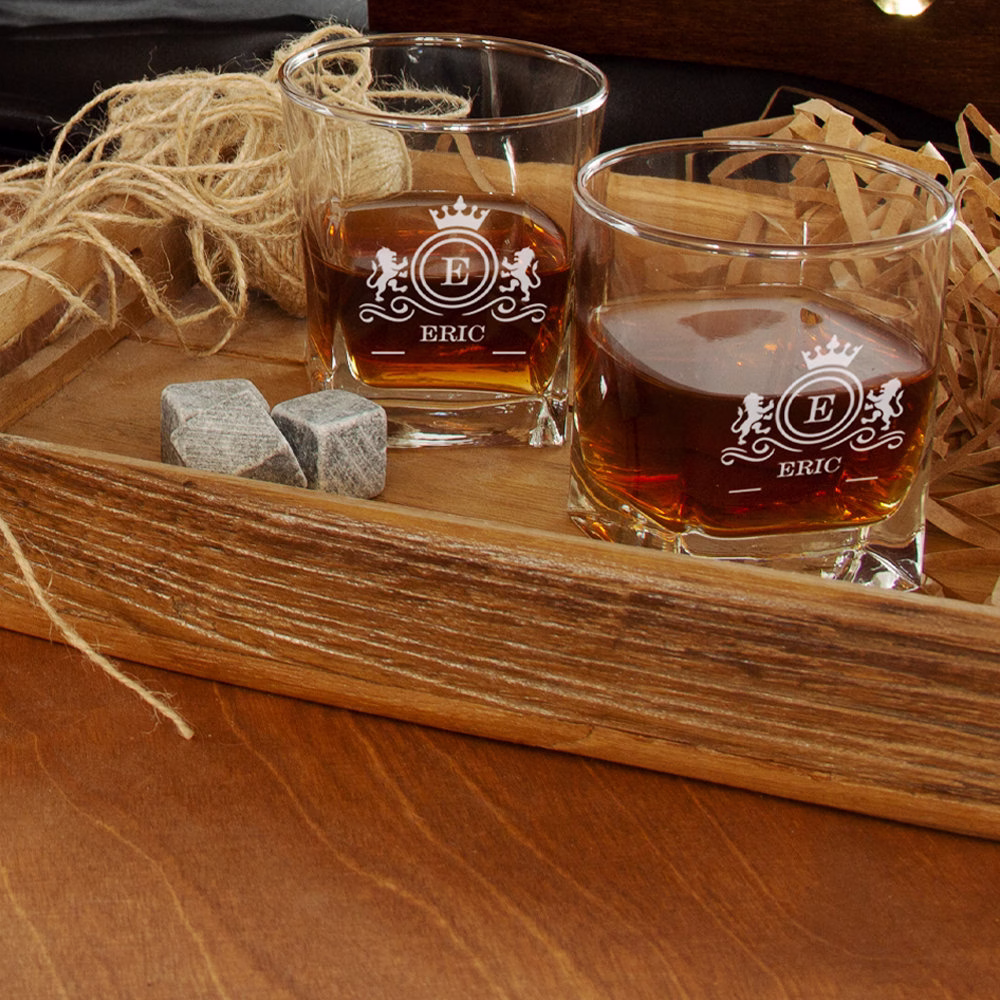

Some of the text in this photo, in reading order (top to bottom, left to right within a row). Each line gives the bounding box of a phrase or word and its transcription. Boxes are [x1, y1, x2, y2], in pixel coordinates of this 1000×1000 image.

[440, 257, 470, 286] E
[419, 325, 486, 343] ERIC
[803, 394, 836, 424] E
[776, 457, 842, 478] ERIC
